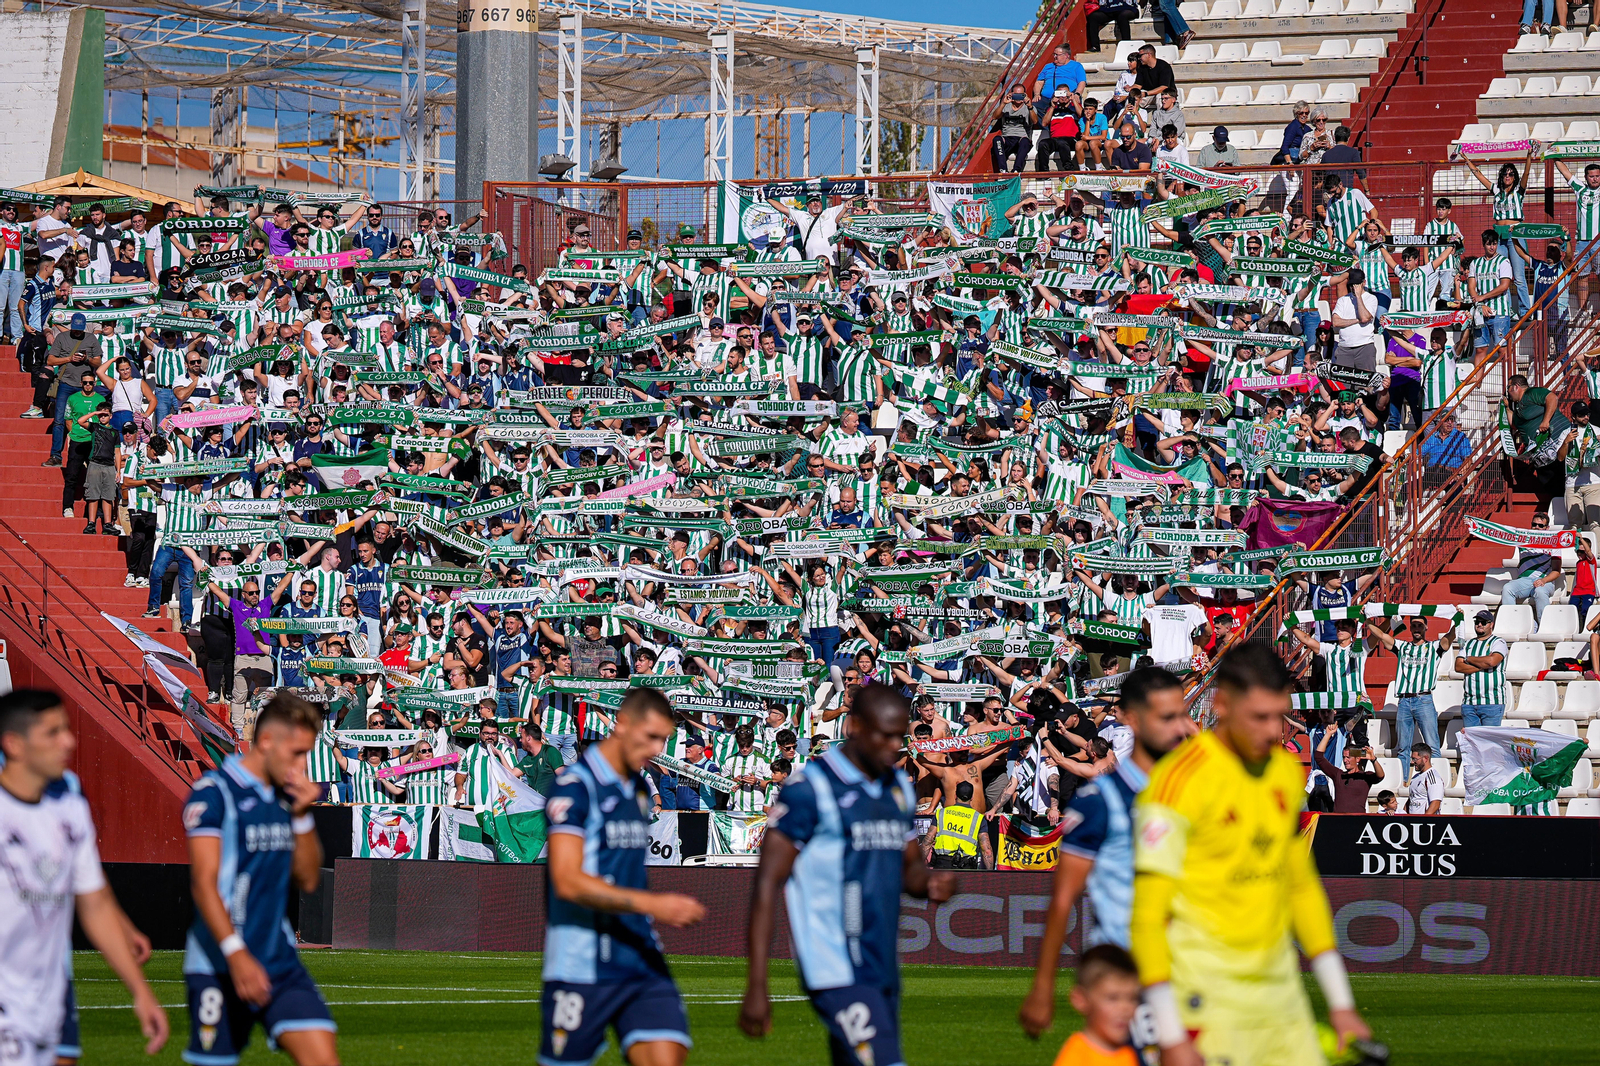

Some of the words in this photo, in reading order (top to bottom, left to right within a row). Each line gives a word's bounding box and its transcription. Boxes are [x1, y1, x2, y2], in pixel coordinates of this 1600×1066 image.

[457, 9, 476, 24] 967
[481, 8, 510, 22] 667
[516, 8, 536, 23] 965
[1206, 176, 1216, 185] DE
[2, 190, 33, 200] CÓRDOBA
[768, 185, 803, 197] FORZA
[829, 182, 857, 194] ALBA
[936, 185, 965, 194] CALIFATO
[1019, 238, 1034, 250] CF
[1429, 236, 1440, 245] CF
[191, 249, 246, 267] CÓRDOBA
[1132, 250, 1181, 263] CÓRDOBA
[1288, 241, 1336, 260] CÓRDOBA
[1338, 256, 1353, 266] CF
[245, 260, 260, 273] CF
[331, 257, 339, 268] CF
[1241, 260, 1294, 272] CÓRDOBA
[1297, 262, 1312, 273] CF
[501, 276, 514, 286] CF
[605, 270, 619, 280] CF
[957, 275, 1004, 286] CÓRDOBA
[1006, 277, 1020, 287] CF
[366, 294, 377, 303] CF
[1423, 315, 1431, 324] DE
[532, 336, 580, 347] CÓRDOBA
[583, 335, 597, 344] CF
[875, 335, 925, 346] CÓRDOBA
[926, 334, 939, 342] CF
[261, 349, 274, 358] CF
[368, 372, 419, 381] CÓRDOBA
[1331, 365, 1370, 381] Córdoba
[750, 381, 765, 390] CF
[1280, 375, 1289, 385] CF
[1059, 397, 1112, 409] Córdoba
[335, 408, 406, 420] CÓRDOBA
[609, 405, 653, 414] CÓRDOBA
[178, 412, 203, 424] Mujer
[555, 414, 570, 423] CF
[493, 429, 537, 438] CÓRDOB
[706, 421, 739, 431] PADRES
[750, 426, 777, 435] HIJOS
[768, 438, 780, 449] CF
[353, 495, 368, 505] CF
[461, 494, 514, 516] CÓRDOBA
[584, 500, 624, 511] CÓRDOB
[941, 495, 993, 513] CÓRDOBA
[1032, 501, 1050, 511] CF
[228, 502, 272, 511] CÓRDOBA
[423, 518, 451, 537] ESTAMOS
[790, 517, 807, 528] CF
[188, 538, 257, 546] COLLECTOR
[1155, 533, 1200, 542] CÓRDOBA
[1205, 534, 1223, 542] C.F.
[1480, 526, 1516, 543] A4CIENTOS
[1517, 534, 1527, 543] DE
[1528, 536, 1558, 546] MADRID
[1240, 550, 1277, 560] CÓRDOBA
[1300, 555, 1359, 567] CÓRDOBA
[1361, 553, 1377, 564] CF
[410, 569, 461, 582] CÓRDOBA
[463, 571, 477, 582] CF
[1202, 574, 1257, 583] CÓRDOBA
[680, 590, 707, 599] ESTAMOS
[708, 588, 740, 598] VOLVIENDO
[992, 584, 1042, 599] CÓRDOBA
[1047, 588, 1067, 598] C.F.
[737, 606, 791, 616] CÓRDOBA
[262, 620, 286, 629] MUSEO
[637, 611, 695, 636] CÓRDOBA
[712, 643, 772, 655] CÓRDOBA
[1033, 642, 1049, 655] CF
[311, 660, 334, 669] MUSEO
[640, 676, 682, 686] CÓRDOBA
[745, 681, 794, 694] CÓRDOBA
[405, 697, 441, 709] CÓRDOBA
[676, 695, 689, 704] DE
[690, 696, 724, 707] PADRES
[734, 700, 760, 710] HIJOS
[502, 726, 514, 734] CF
[945, 808, 972, 820] SEGURIDAD
[947, 822, 964, 835] 044
[1356, 822, 1462, 850] AQUA
[498, 840, 522, 864] FÚTBOL
[1360, 852, 1457, 877] DEUS
[198, 986, 223, 1026] 8
[552, 989, 585, 1032] 18
[835, 1002, 877, 1047] 12
